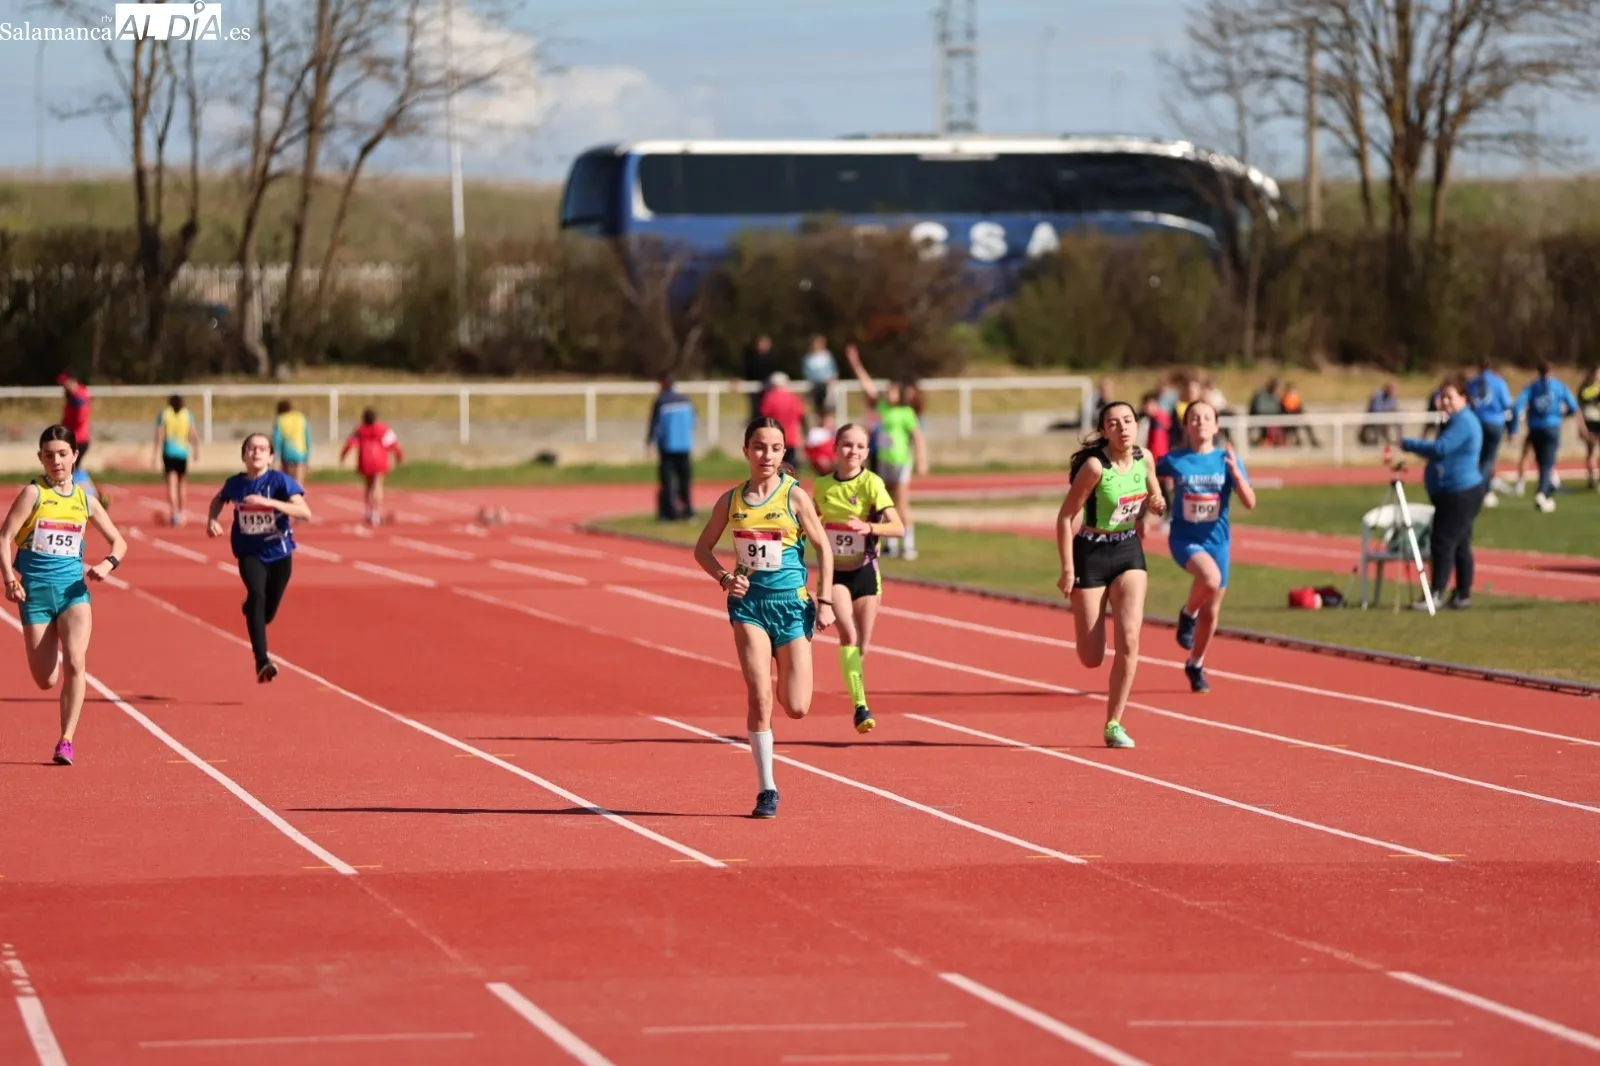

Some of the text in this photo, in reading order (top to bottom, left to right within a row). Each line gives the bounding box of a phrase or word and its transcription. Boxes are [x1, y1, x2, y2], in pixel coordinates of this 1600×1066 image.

[46, 533, 73, 547] 155
[835, 534, 853, 547] 59
[747, 543, 767, 558] 91
